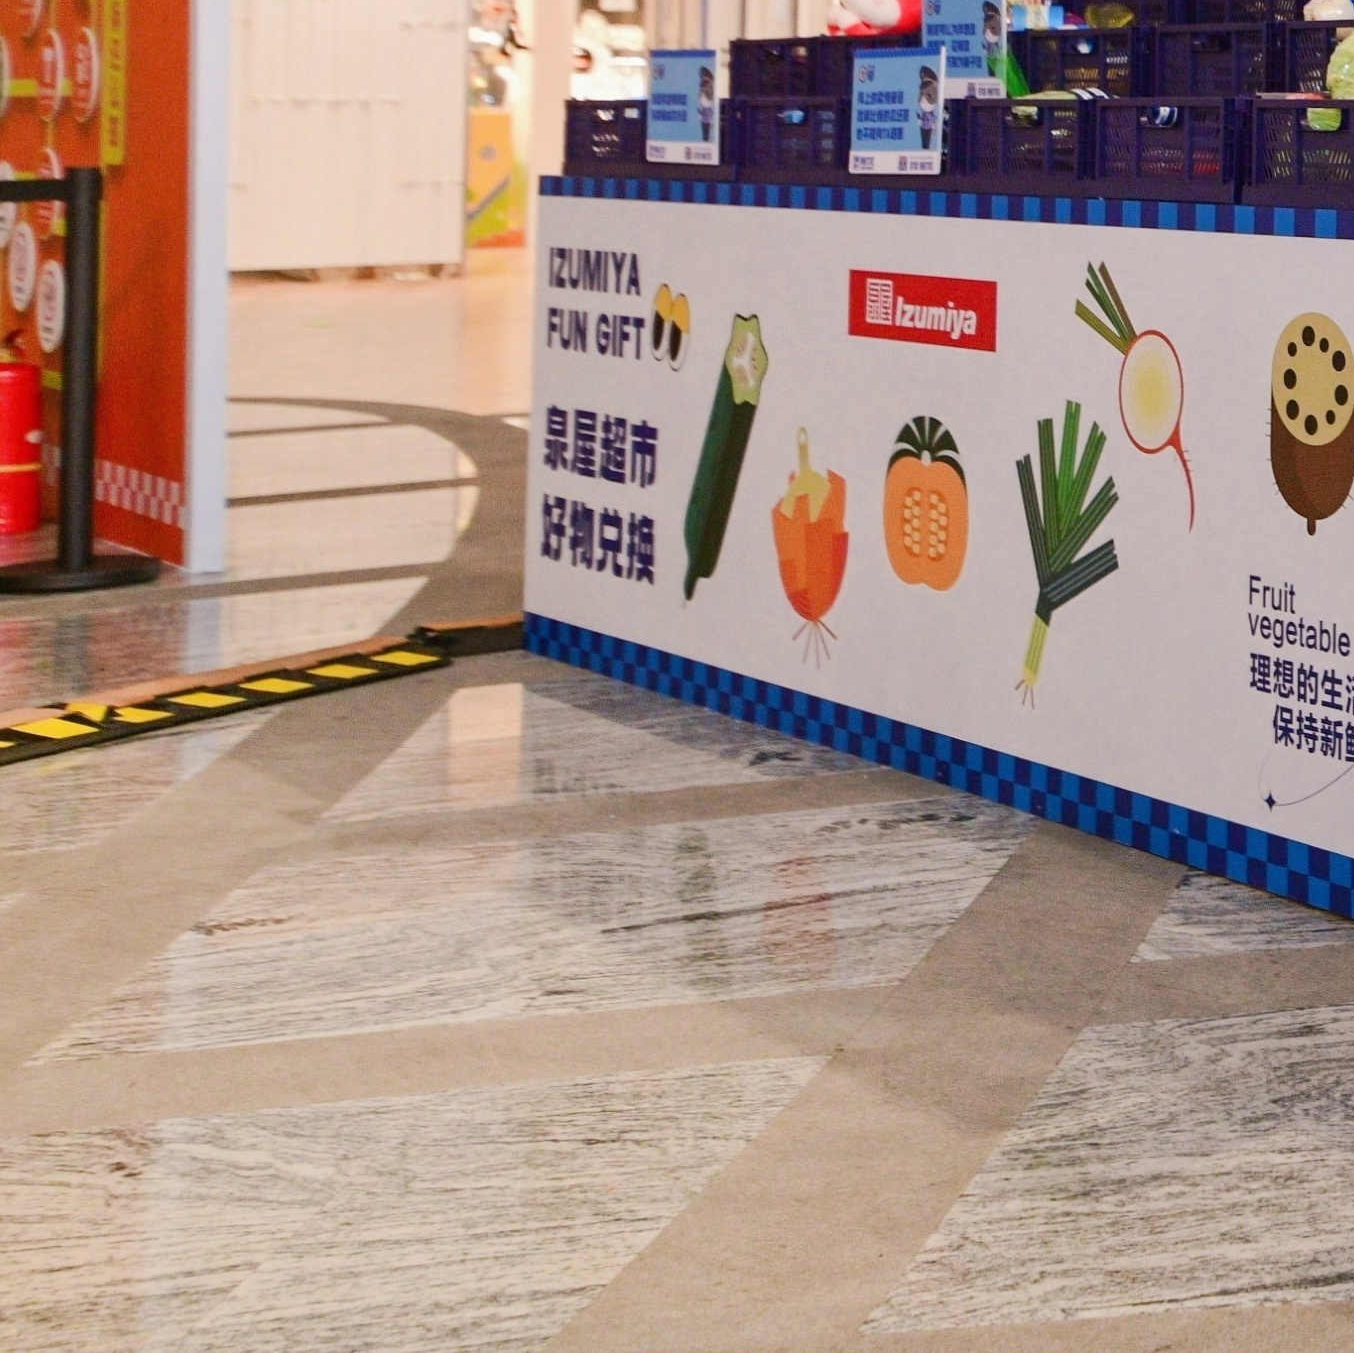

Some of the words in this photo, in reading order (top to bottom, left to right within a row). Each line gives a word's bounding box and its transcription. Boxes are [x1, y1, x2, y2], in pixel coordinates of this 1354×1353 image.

[548, 246, 642, 297] IZUMIYA
[547, 307, 588, 352] FUN
[595, 312, 646, 361] GIFT
[895, 295, 977, 340] Izumiya
[543, 404, 660, 489] 泉屋超市
[540, 493, 656, 586] 好物兑换
[1249, 575, 1297, 613] Fruit
[1248, 612, 1351, 657] vegetable
